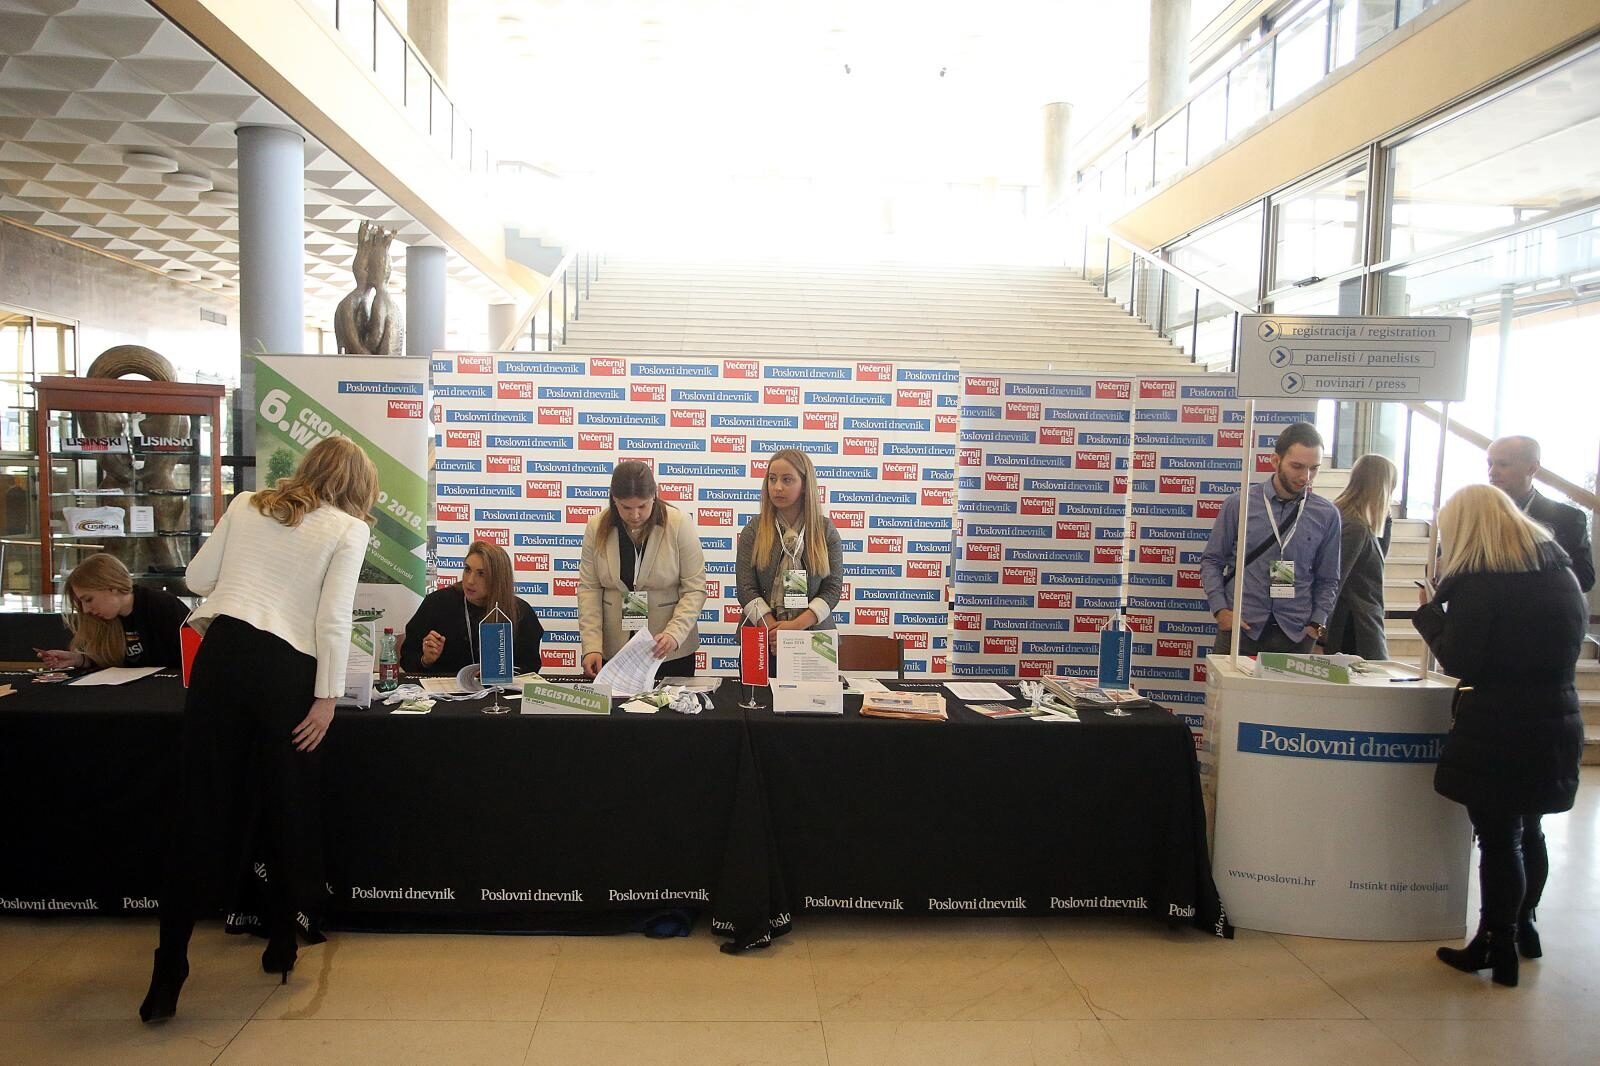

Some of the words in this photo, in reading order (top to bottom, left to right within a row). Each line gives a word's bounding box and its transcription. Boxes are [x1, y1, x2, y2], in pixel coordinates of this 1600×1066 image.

[1292, 325, 1356, 340] registracija
[1367, 327, 1436, 340] registration
[459, 356, 492, 366] Večernji
[592, 358, 625, 368] Večernji
[1305, 351, 1356, 365] panelisti
[1367, 352, 1420, 366] panelists
[479, 365, 492, 373] list
[506, 362, 543, 373] Poslovni
[543, 363, 579, 373] dnevnik
[612, 367, 625, 375] list
[639, 365, 676, 375] Poslovni
[676, 366, 712, 376] dnevnik
[725, 361, 758, 370] Večernji
[859, 364, 891, 373] Večernji
[772, 368, 809, 378] Poslovni
[809, 368, 845, 378] dnevnik
[879, 372, 891, 380] list
[346, 383, 381, 393] Poslovni
[382, 384, 417, 393] dnevnik
[499, 382, 532, 391] Večernji
[967, 378, 999, 387] Večernji
[1315, 377, 1365, 389] novinari
[1375, 380, 1406, 392] press
[519, 390, 532, 398] list
[546, 388, 583, 398] Poslovni
[583, 389, 619, 399] dnevnik
[899, 389, 931, 399] Večernji
[1013, 384, 1049, 394] Poslovni
[1049, 385, 1085, 395] dnevnik
[679, 390, 716, 401] Poslovni
[716, 391, 752, 401] dnevnik
[812, 393, 849, 403] Poslovni
[850, 394, 886, 404] dnevnik
[390, 401, 422, 411] Večernji
[919, 398, 931, 406] list
[1007, 403, 1039, 412] Večernji
[260, 388, 292, 432] 6.
[1052, 410, 1089, 420] Poslovni
[1089, 410, 1125, 420] dnevnik
[1184, 405, 1217, 415] Večernji
[454, 411, 491, 421] Poslovni
[491, 412, 527, 422] dnevnik
[586, 414, 623, 424] Poslovni
[623, 414, 659, 425] dnevnik
[719, 416, 756, 426] Poslovni
[756, 417, 792, 427] dnevnik
[805, 412, 838, 422] Večernji
[1203, 414, 1217, 422] list
[825, 421, 838, 429] list
[851, 419, 888, 429] Poslovni
[888, 420, 924, 430] dnevnik
[448, 430, 481, 440] Večernji
[713, 435, 745, 445] Večernji
[66, 437, 122, 447] LISINSKI
[140, 436, 193, 447] LISINSKI
[468, 439, 481, 447] list
[494, 437, 531, 447] Poslovni
[531, 437, 567, 448] dnevnik
[626, 439, 663, 449] Poslovni
[664, 440, 700, 450] dnevnik
[733, 444, 745, 452] list
[993, 455, 1030, 465] Poslovni
[1030, 456, 1066, 466] dnevnik
[1078, 452, 1110, 462] Večernji
[534, 462, 571, 472] Poslovni
[572, 463, 608, 473] dnevnik
[666, 464, 704, 475] Poslovni
[704, 465, 740, 475] dnevnik
[442, 485, 480, 495] Poslovni
[480, 486, 516, 496] dnevnik
[528, 481, 561, 490] Večernji
[839, 492, 875, 502] Poslovni
[875, 493, 910, 503] dnevnik
[1022, 498, 1054, 507] Večernji
[387, 498, 423, 530] 2018.
[437, 504, 469, 513] Večernji
[457, 512, 469, 520] list
[482, 510, 519, 520] Poslovni
[519, 511, 555, 521] dnevnik
[877, 517, 914, 527] Poslovni
[914, 518, 949, 528] dnevnik
[975, 525, 1011, 535] Poslovni
[1011, 526, 1047, 536] dnevnik
[870, 536, 902, 545] Večernji
[1013, 550, 1048, 559] Poslovni
[1049, 550, 1084, 560] dnevnik
[1142, 546, 1174, 556] Večernji
[1161, 555, 1174, 563] list
[1004, 568, 1036, 577] Večernji
[1023, 576, 1036, 584] list
[863, 589, 899, 599] Poslovni
[899, 590, 934, 600] dnevnik
[985, 637, 1017, 646] Večernji
[543, 650, 575, 659] Večernji
[758, 646, 766, 670] Večernji
[1286, 659, 1330, 678] PRESS
[534, 686, 601, 709] REGISTRACIJA
[1259, 729, 1356, 756] Poslovni
[1360, 736, 1448, 759] dnevnik
[1228, 868, 1317, 887] www.poslovni.hr
[1349, 880, 1388, 890] Instinkt
[1390, 882, 1408, 893] nije
[1409, 881, 1449, 893] dovoljan
[351, 887, 403, 900] Poslovni
[405, 888, 456, 901] dnevnik
[480, 888, 532, 901] Poslovni
[534, 889, 584, 902] dnevnik
[608, 889, 660, 901] Poslovni
[661, 889, 710, 901] dnevnik
[0, 898, 46, 910] Poslovni
[48, 899, 99, 910] dnevnik
[804, 896, 853, 909] Poslovni
[855, 897, 904, 910] dnevnik
[927, 898, 977, 910] Poslovni
[978, 897, 1027, 910] dnevnik
[1049, 896, 1098, 909] Poslovni
[1099, 897, 1148, 910] dnevnik
[1168, 903, 1196, 917] Poslo
